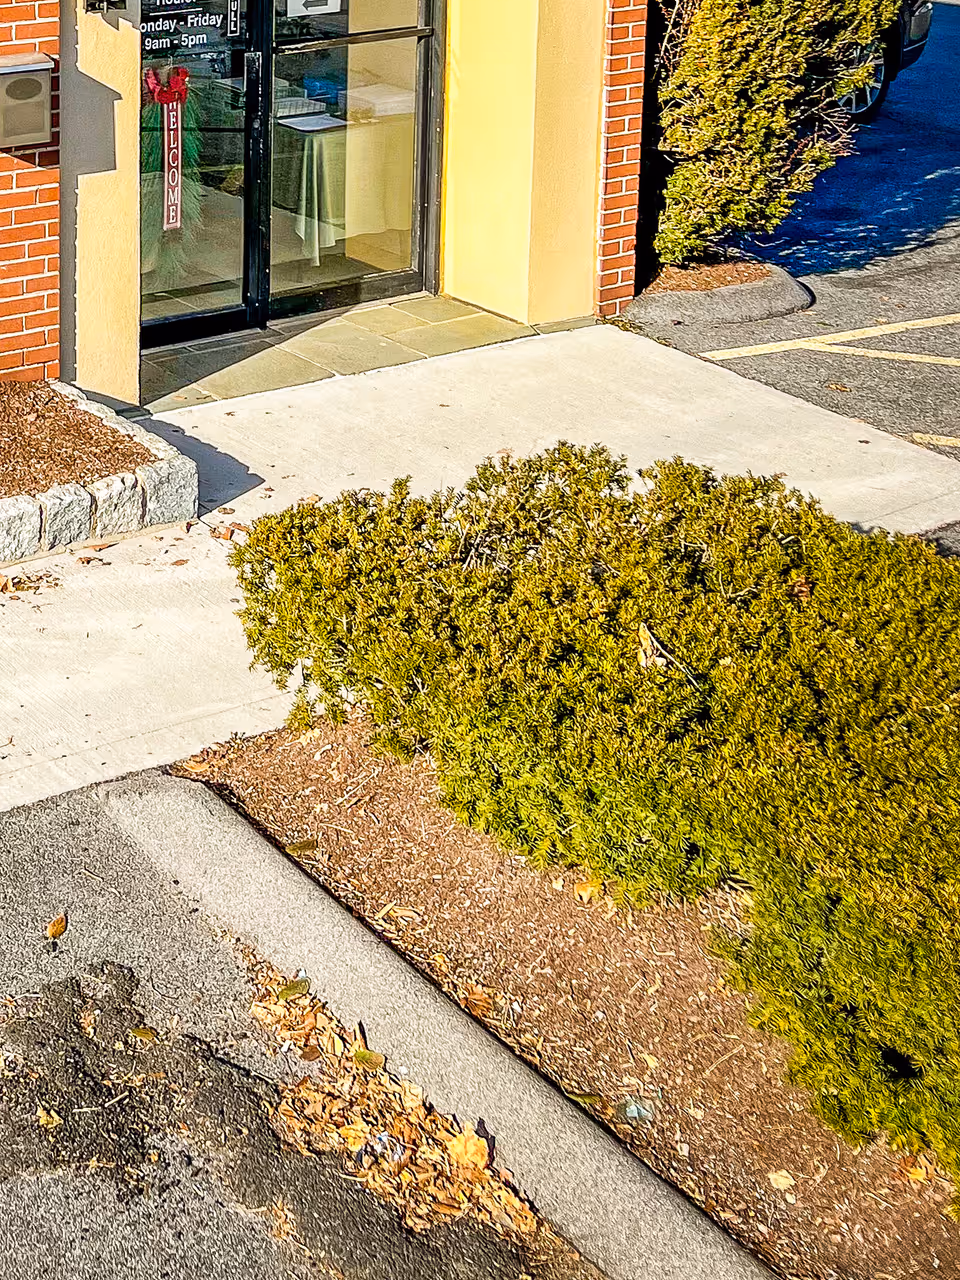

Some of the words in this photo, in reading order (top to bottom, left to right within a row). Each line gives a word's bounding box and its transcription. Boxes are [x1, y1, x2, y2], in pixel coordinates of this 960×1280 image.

[187, 13, 223, 28] Friday
[145, 37, 171, 50] 9am
[181, 33, 207, 48] 5pm
